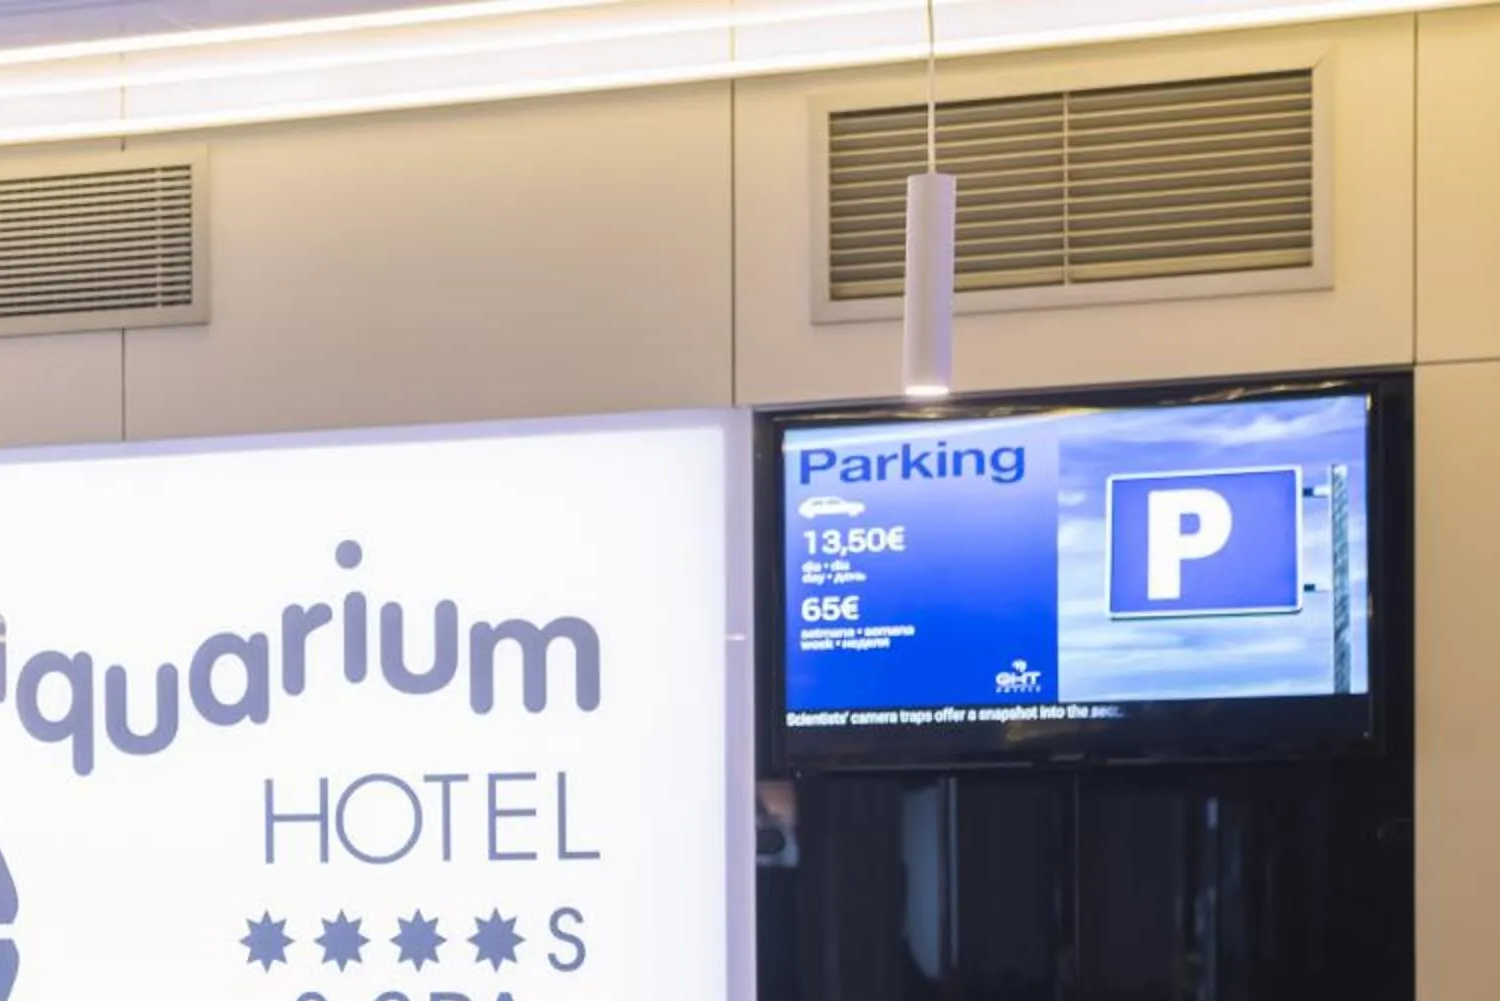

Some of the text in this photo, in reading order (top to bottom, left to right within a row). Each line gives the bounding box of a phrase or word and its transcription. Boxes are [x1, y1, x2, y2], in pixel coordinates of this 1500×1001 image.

[799, 441, 1026, 486] Parking
[802, 525, 907, 557] 13,50€
[1147, 487, 1233, 600] P
[801, 595, 860, 622] 65€
[851, 710, 898, 725] camera
[899, 709, 933, 725] traps
[934, 705, 966, 723] offer
[967, 708, 978, 722] a
[978, 705, 1038, 723] snapshot
[1039, 704, 1065, 719] into
[1067, 703, 1089, 719] the
[264, 772, 601, 865] HOTEL
[547, 906, 587, 973] S
